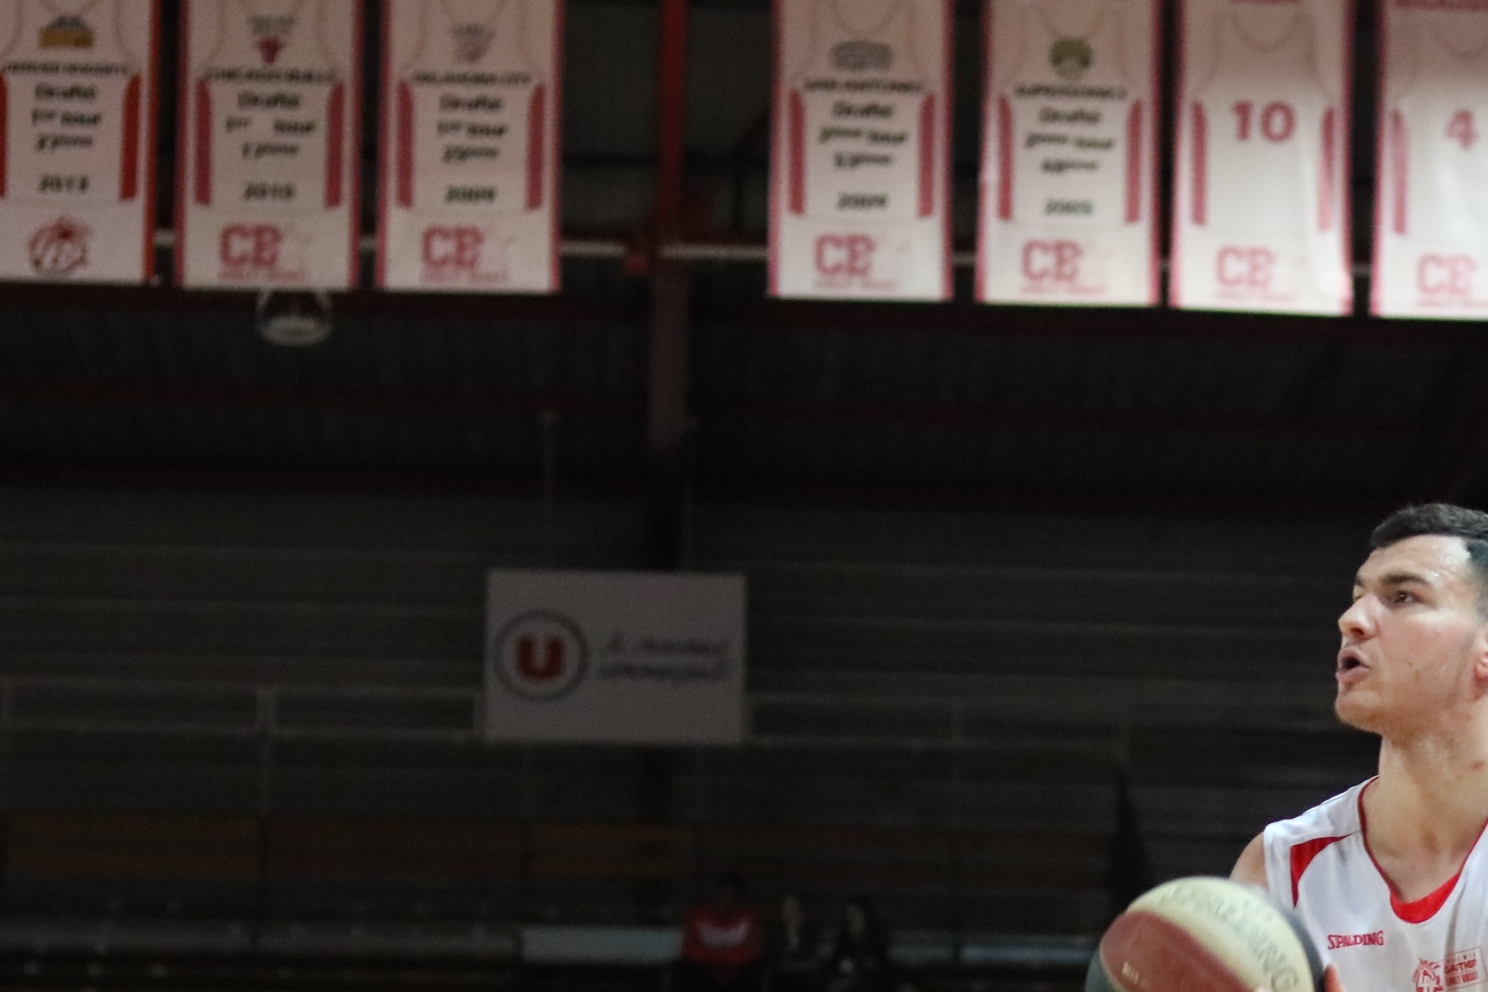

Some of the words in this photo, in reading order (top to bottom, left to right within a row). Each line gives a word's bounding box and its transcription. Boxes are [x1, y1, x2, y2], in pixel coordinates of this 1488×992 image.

[1231, 99, 1297, 144] 10
[1444, 107, 1479, 151] 4
[1327, 930, 1384, 950] SPALDING
